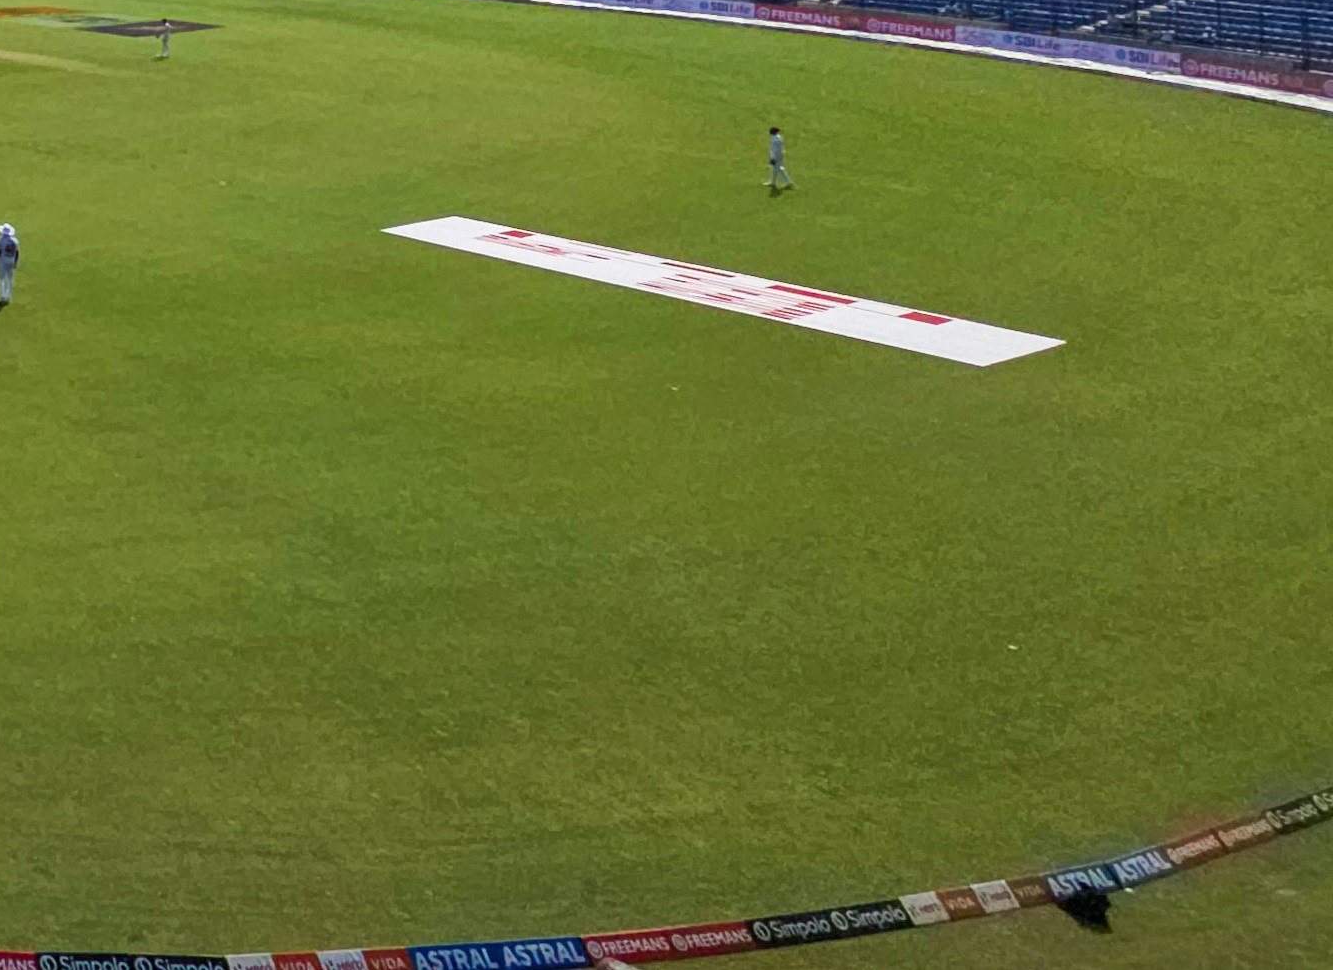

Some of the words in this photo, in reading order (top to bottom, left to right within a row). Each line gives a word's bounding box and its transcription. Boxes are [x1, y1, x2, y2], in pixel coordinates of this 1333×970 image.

[771, 8, 841, 27] FREEMANS
[882, 20, 954, 40] FREEMANS
[1037, 36, 1062, 51] Life
[1199, 63, 1280, 86] FREEMANS
[1048, 867, 1115, 898] ASTRAL
[1112, 850, 1173, 883] ASTRAL
[947, 895, 976, 911] VIDA
[770, 917, 831, 940] Simpolo
[845, 903, 906, 929] Simpolo
[601, 936, 670, 955] FREEMANS
[686, 928, 752, 949] FREEMANS
[370, 957, 406, 970] VIDA
[414, 946, 499, 970] ASTRAL
[503, 941, 586, 969] ASTRAL
